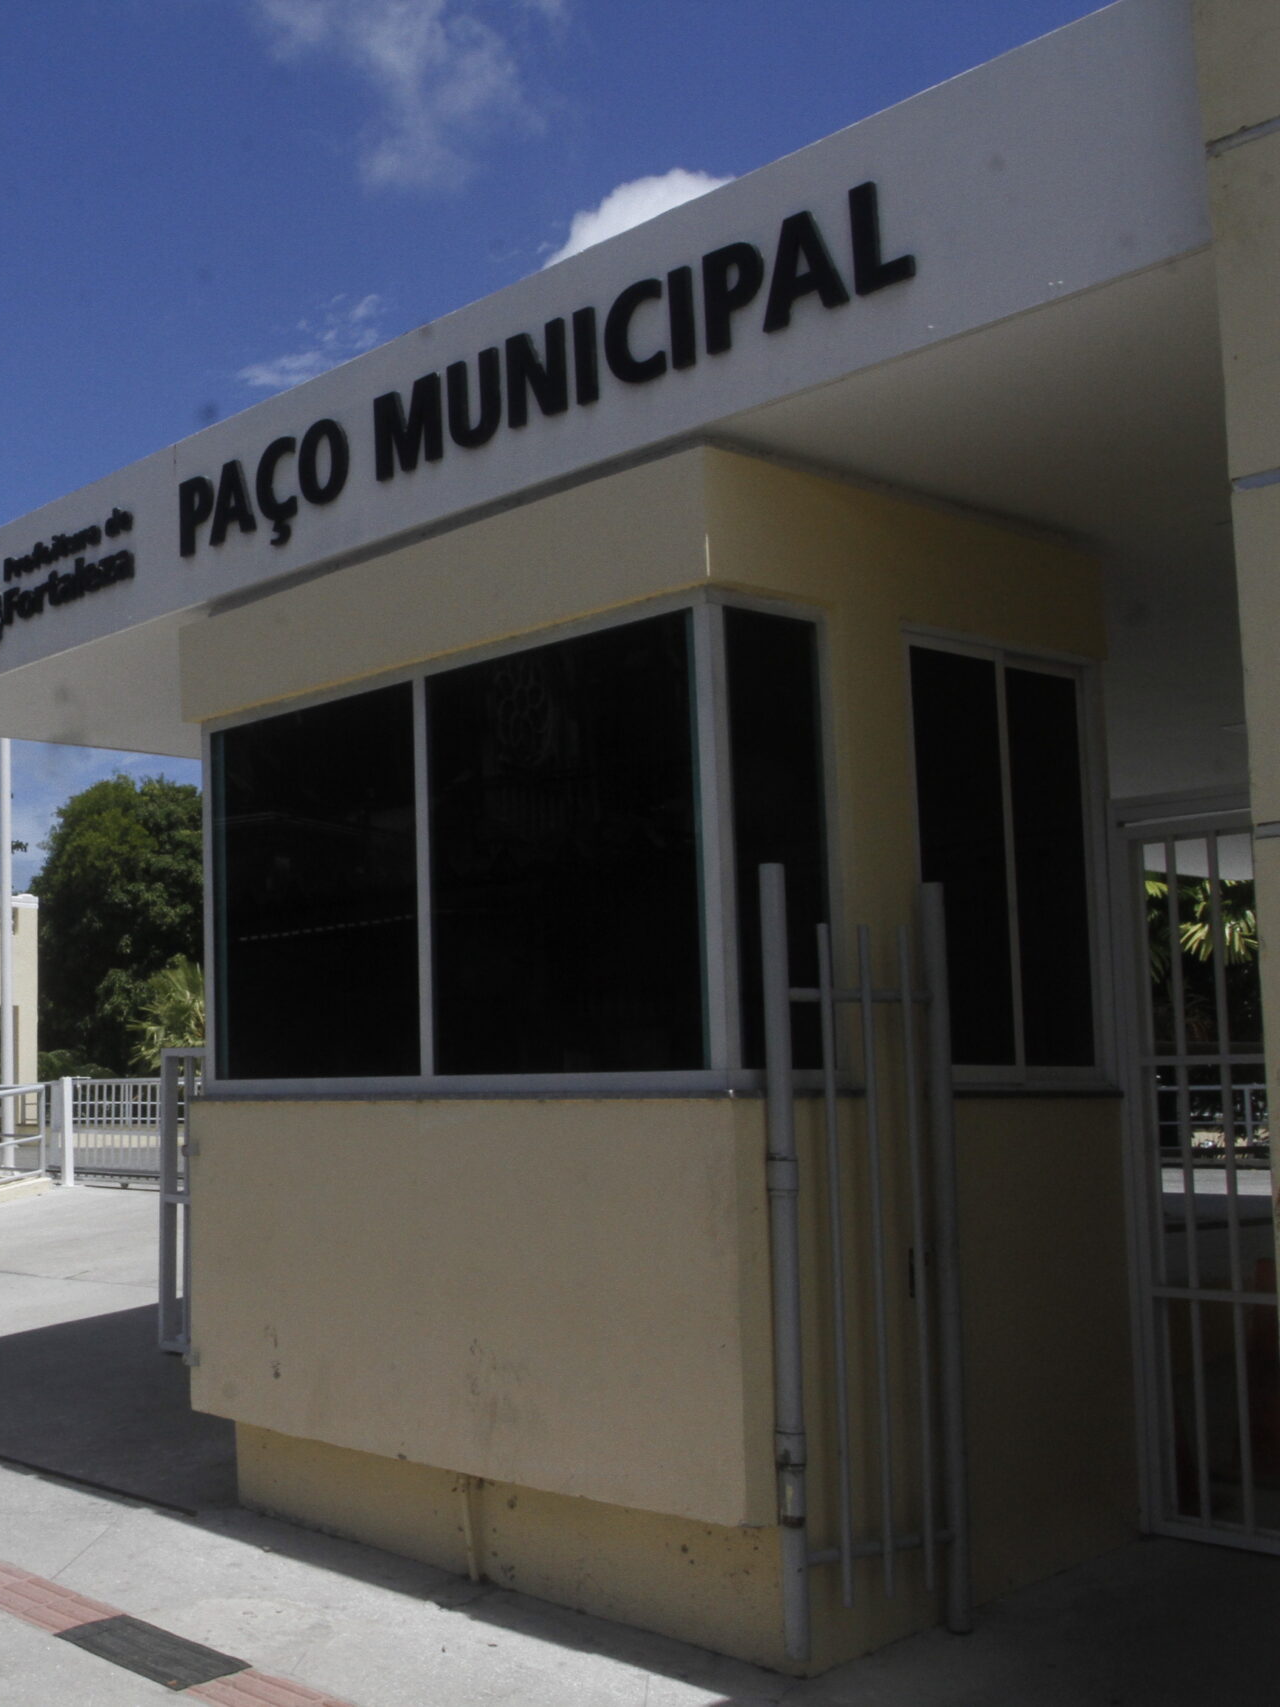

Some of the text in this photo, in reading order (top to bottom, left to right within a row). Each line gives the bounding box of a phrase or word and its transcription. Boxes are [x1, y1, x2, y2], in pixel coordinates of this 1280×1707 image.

[178, 181, 917, 558] PAÇO MUNICIPAL
[3, 507, 134, 582] Prefeitura de
[3, 549, 135, 626] Fortaleza
